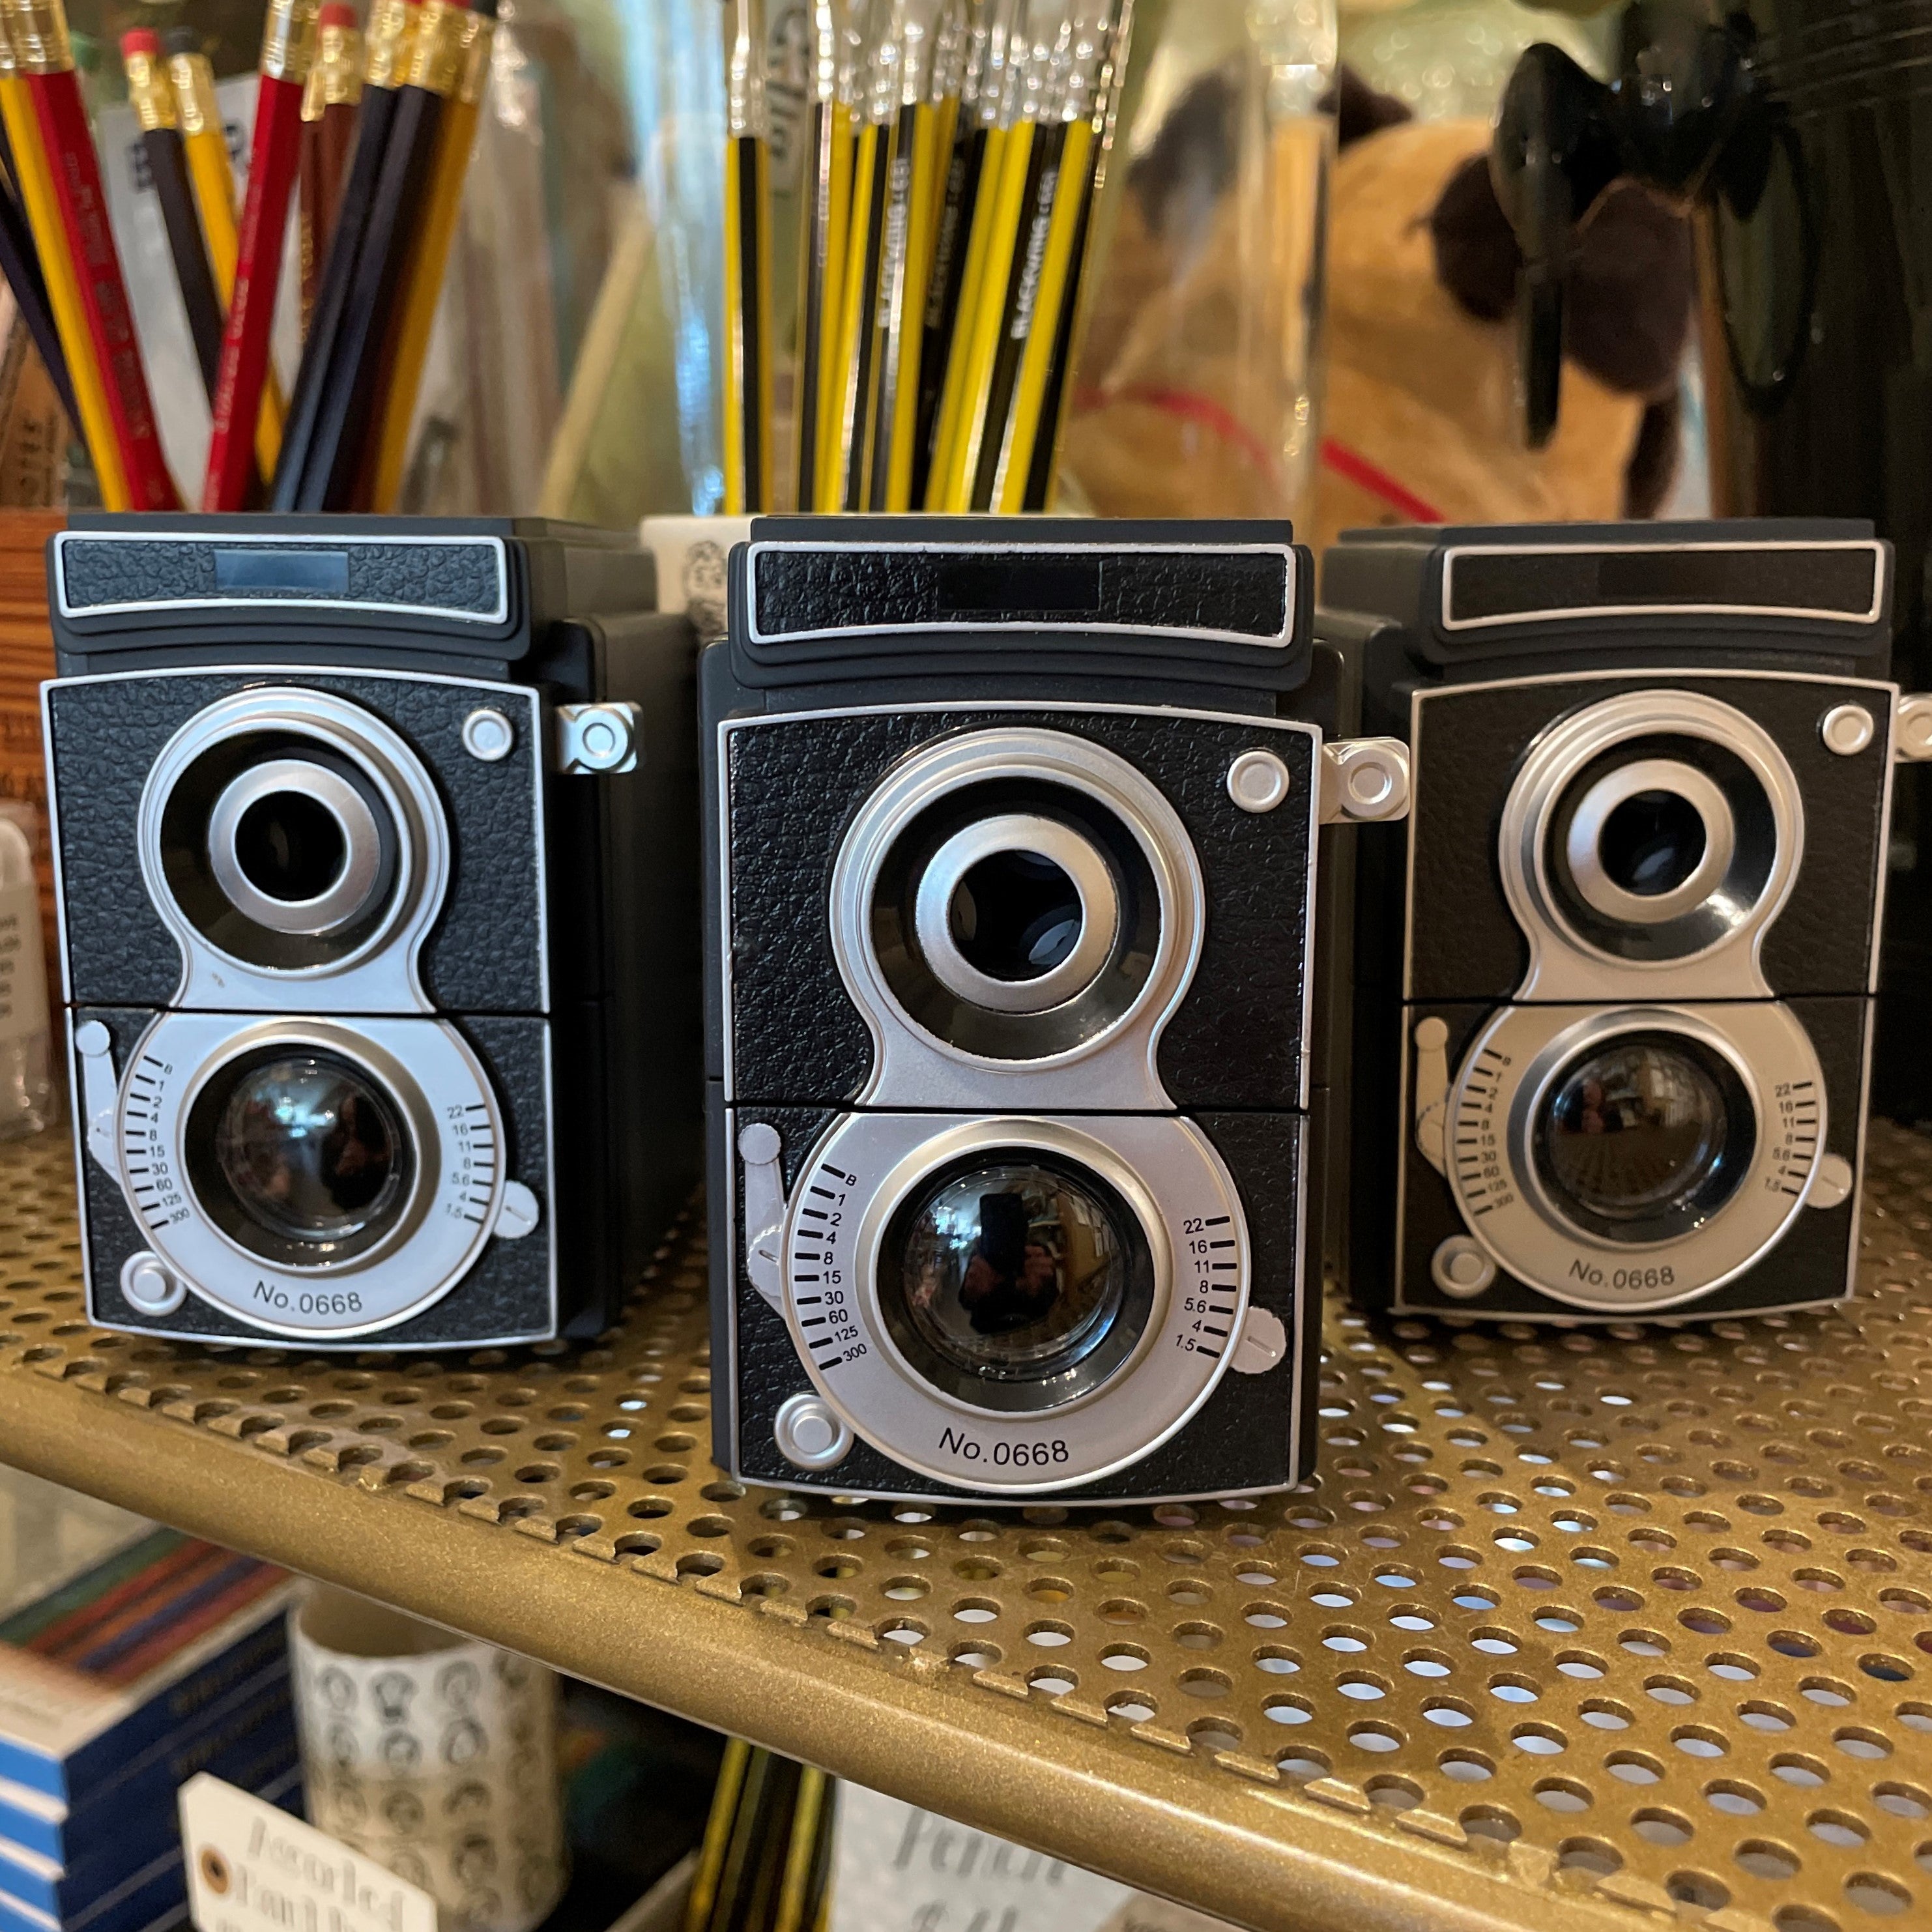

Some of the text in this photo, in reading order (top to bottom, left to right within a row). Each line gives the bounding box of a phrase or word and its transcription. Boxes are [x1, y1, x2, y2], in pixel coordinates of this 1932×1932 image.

[158, 1080, 165, 1091] 1
[152, 1096, 162, 1108] 2
[151, 1112, 158, 1123] 4
[447, 1104, 464, 1119] 22
[1783, 1117, 1794, 1128] 11
[149, 1129, 157, 1141] 8
[452, 1123, 469, 1136] 16
[150, 1145, 165, 1158] 15
[458, 1141, 471, 1153] 11
[151, 1162, 168, 1175] 30
[463, 1157, 471, 1170] 8
[156, 1177, 173, 1191] 60
[845, 1174, 857, 1186] B
[162, 1192, 182, 1207] 125
[459, 1191, 467, 1202] 4
[839, 1194, 846, 1206] 1
[169, 1207, 190, 1224] 300
[830, 1213, 842, 1226] 2
[1183, 1218, 1204, 1234] 22
[826, 1232, 836, 1244] 4
[1189, 1239, 1207, 1254] 16
[824, 1251, 833, 1265] 8
[1194, 1260, 1209, 1273] 11
[823, 1270, 841, 1284] 15
[1569, 1259, 1675, 1290] No.0668
[1200, 1280, 1209, 1293] 8
[253, 1280, 362, 1315] No.0668
[824, 1290, 844, 1305] 30
[1184, 1297, 1207, 1313] 5.6
[829, 1308, 848, 1324] 60
[1192, 1319, 1202, 1332] 4
[835, 1325, 858, 1342] 125
[1176, 1334, 1196, 1351] 1.5
[843, 1343, 867, 1361] 300
[939, 1427, 1069, 1466] No.0668
